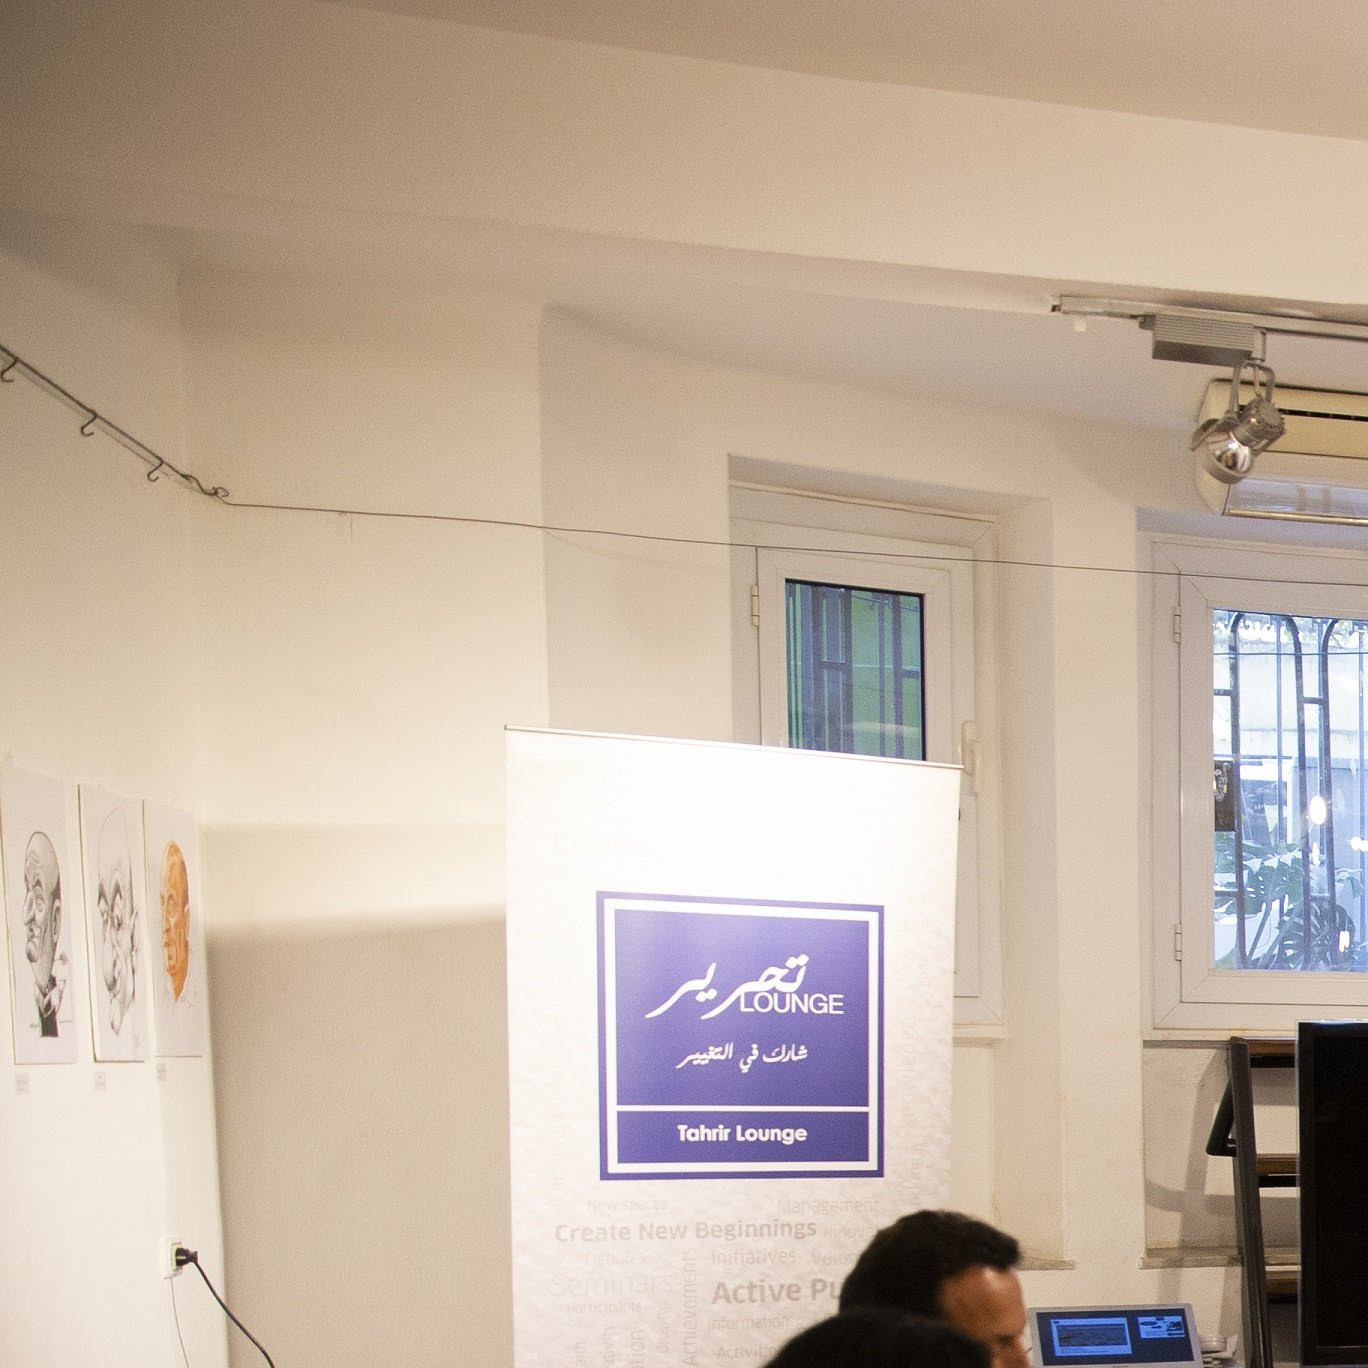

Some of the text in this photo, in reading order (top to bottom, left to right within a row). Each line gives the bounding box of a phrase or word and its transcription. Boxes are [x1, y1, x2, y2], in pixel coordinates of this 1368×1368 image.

[645, 954, 809, 1019] تحرير
[739, 992, 845, 1015] LOUNGE
[676, 1042, 808, 1073] شارك في التغيير
[677, 1124, 808, 1145] Tahrir Lounge
[777, 1199, 881, 1216] Management
[555, 1220, 817, 1242] Create New Beginnings
[712, 1248, 797, 1266] Initiatives
[711, 1278, 842, 1305] Active Pu
[681, 1247, 698, 1367] Achievements
